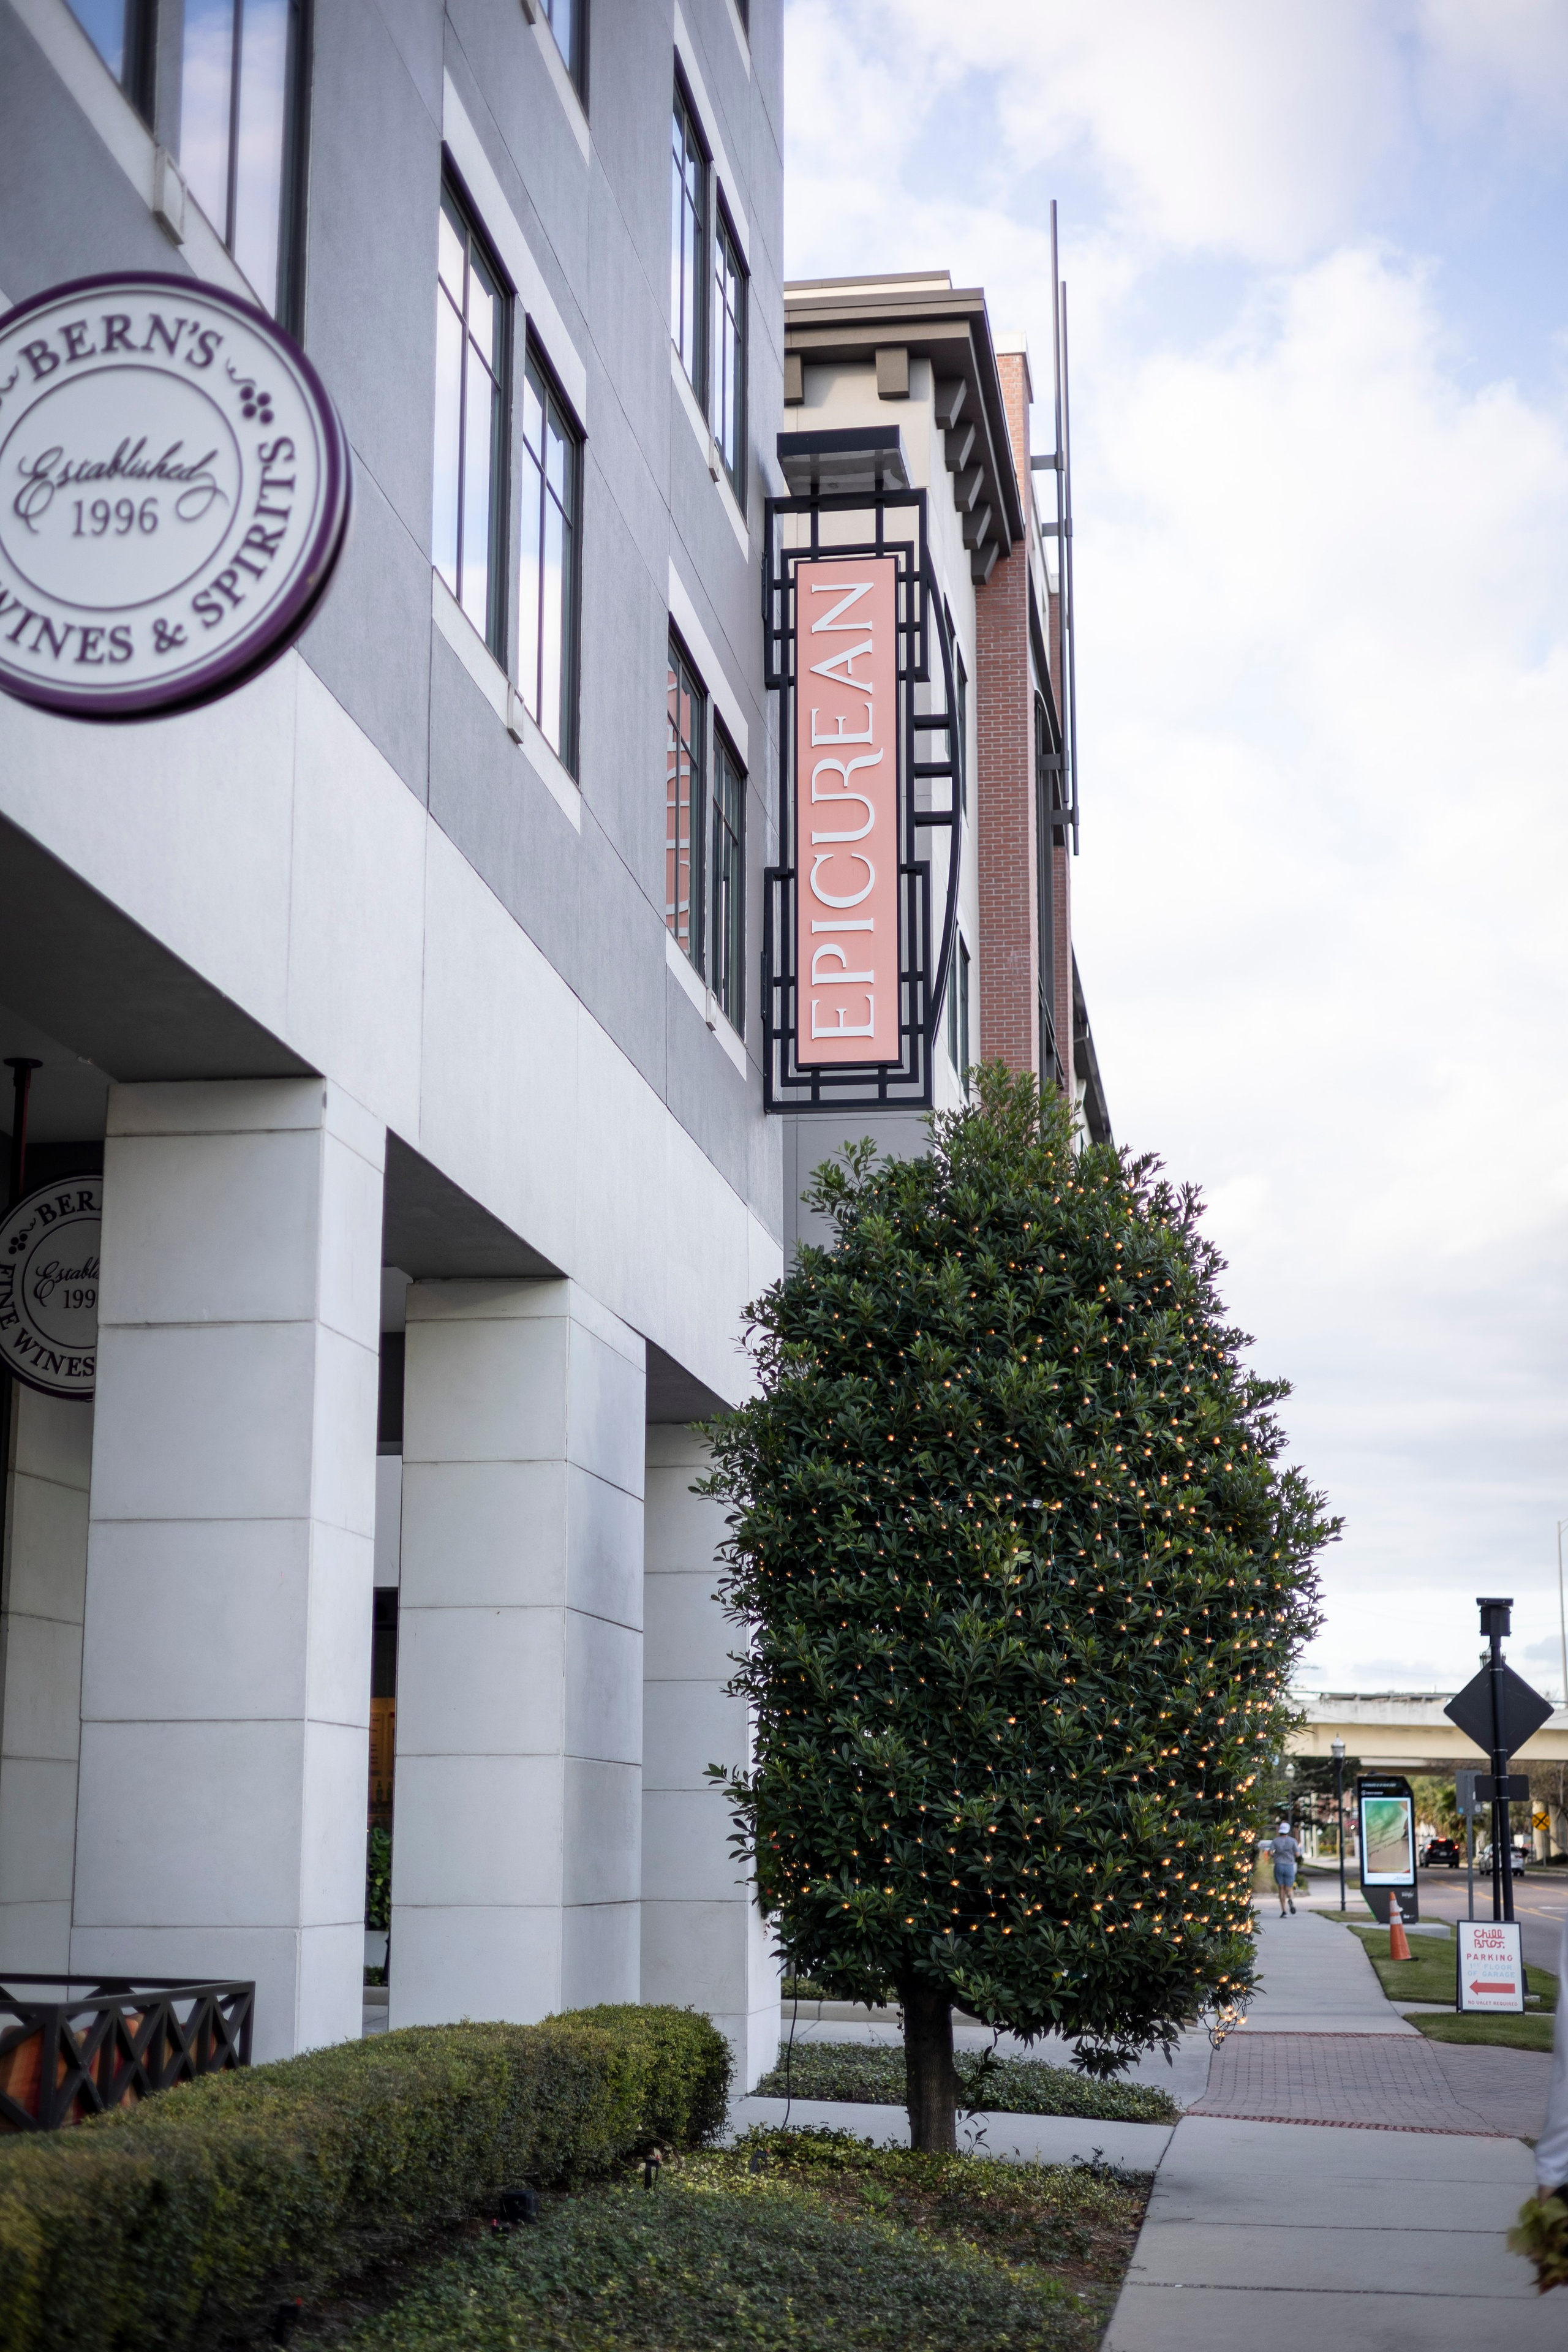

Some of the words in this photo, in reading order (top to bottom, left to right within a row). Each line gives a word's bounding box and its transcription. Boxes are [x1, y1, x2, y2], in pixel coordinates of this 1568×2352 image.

[18, 312, 224, 382] BERN'S
[13, 435, 230, 534] Established
[72, 497, 159, 538] 1996
[152, 617, 187, 654] &
[191, 435, 297, 630] SPIRITS
[810, 581, 884, 1040] EPICUREAN
[34, 1190, 102, 1226] BER
[62, 1289, 96, 1309] 199
[13, 1327, 95, 1378] WINES
[1474, 1929, 1506, 1939] Chill
[1474, 1939, 1506, 1949] Bros.
[1466, 1953, 1513, 1962] PARKING
